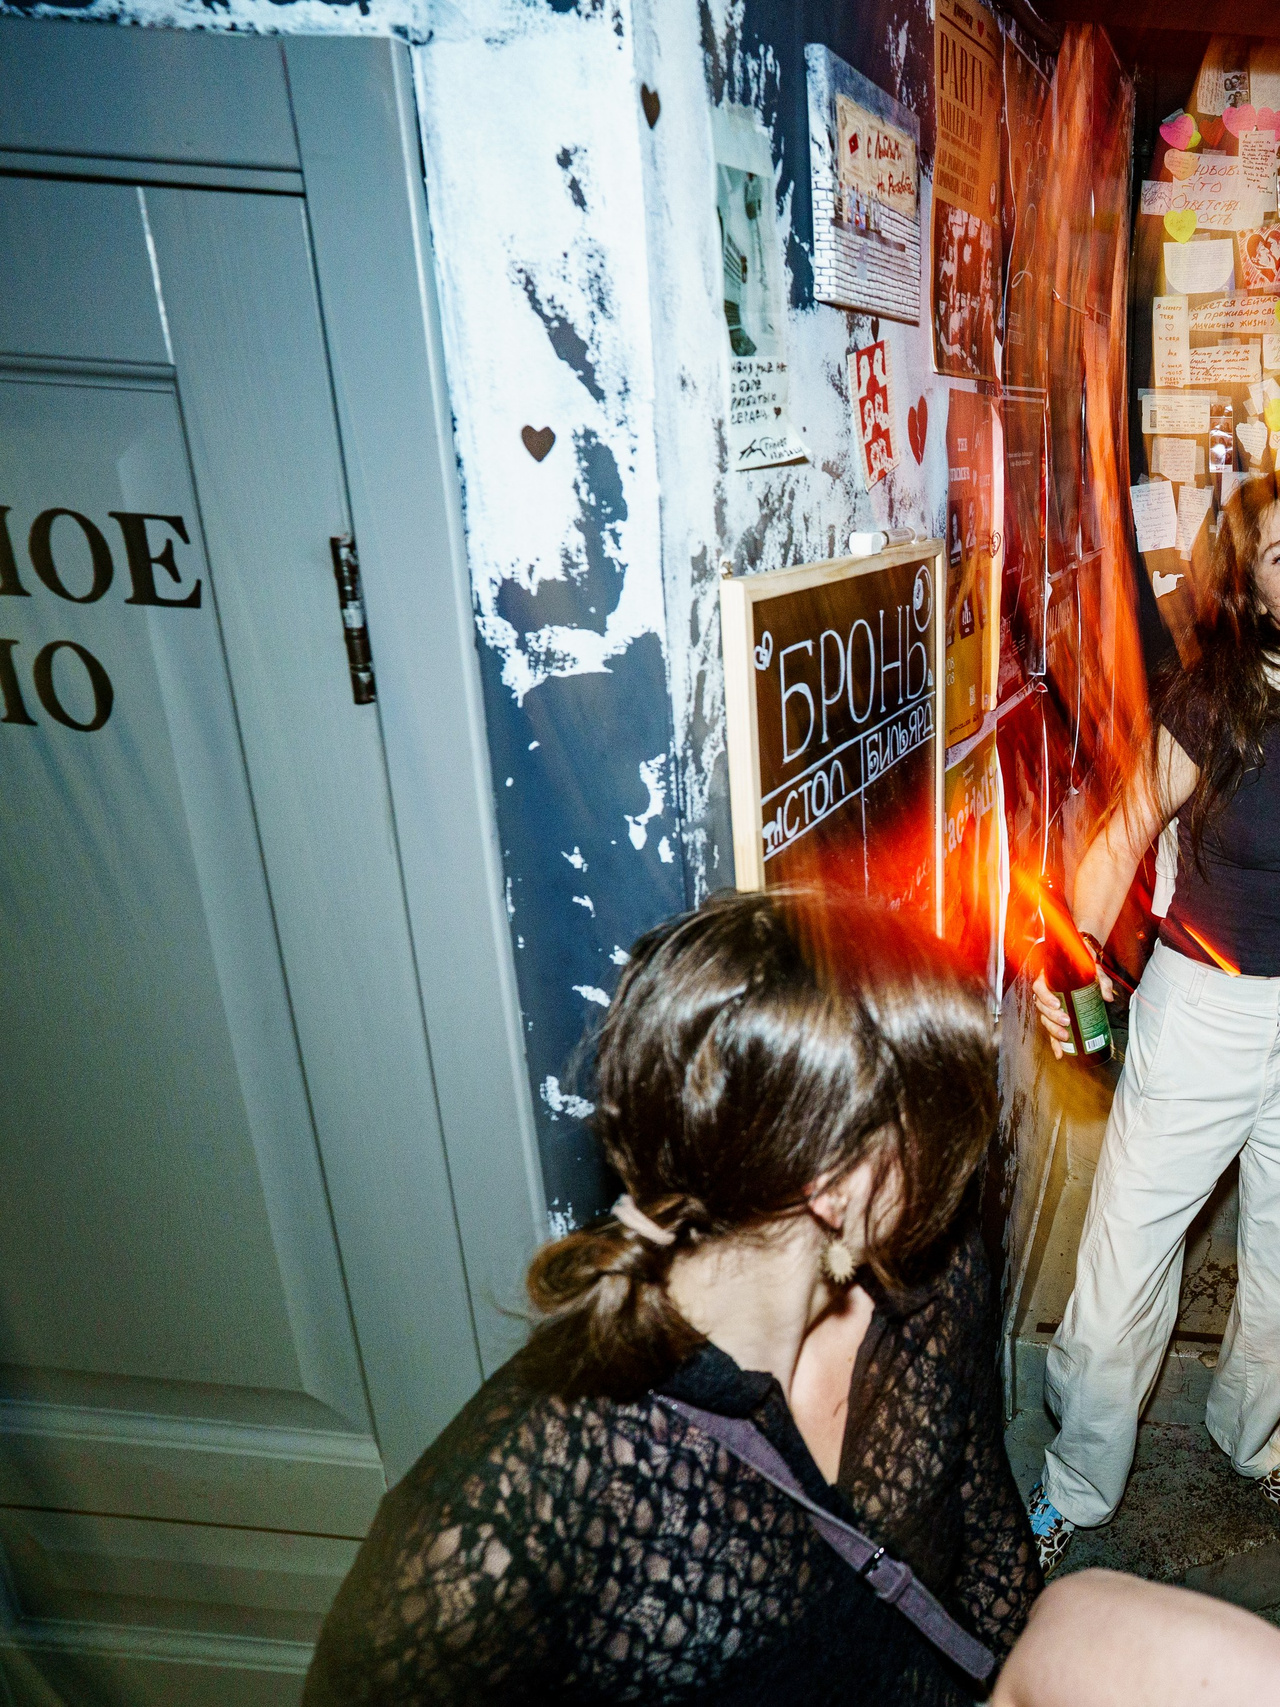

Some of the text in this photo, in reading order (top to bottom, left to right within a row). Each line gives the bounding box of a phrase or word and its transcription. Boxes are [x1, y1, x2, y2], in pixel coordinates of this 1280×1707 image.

[940, 30, 988, 117] PARTY
[779, 604, 927, 764] БРОНЬ
[866, 701, 934, 781] БИЛЬЯРД
